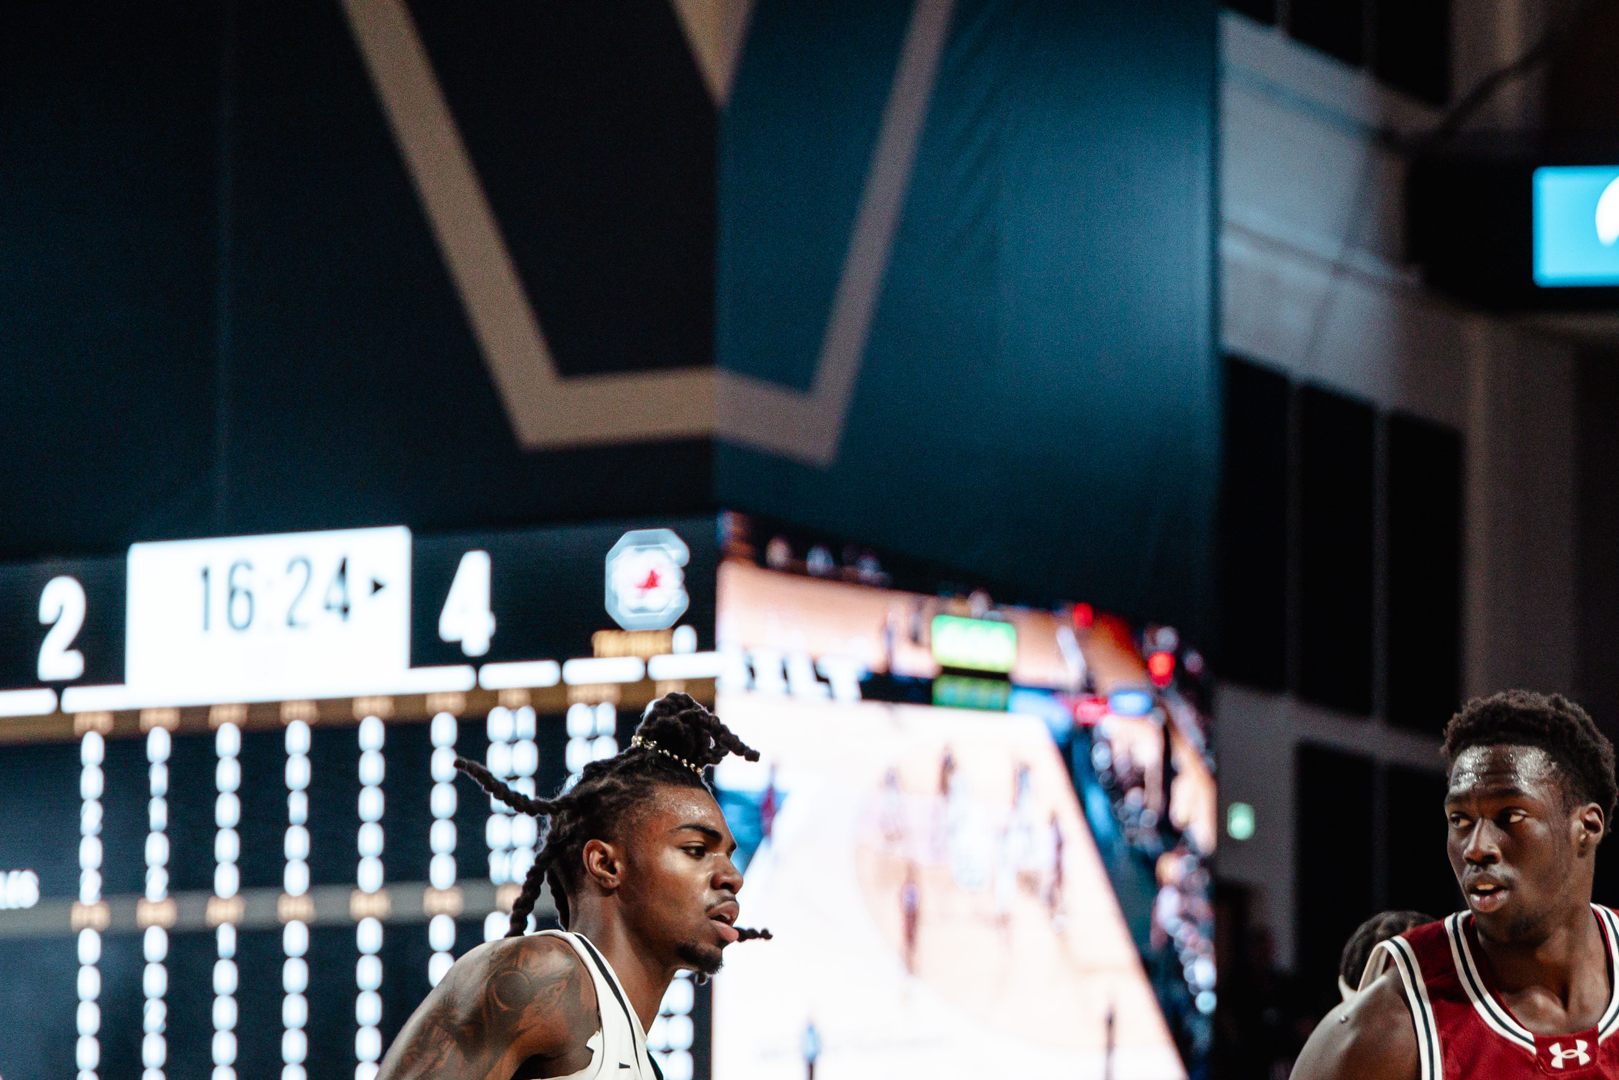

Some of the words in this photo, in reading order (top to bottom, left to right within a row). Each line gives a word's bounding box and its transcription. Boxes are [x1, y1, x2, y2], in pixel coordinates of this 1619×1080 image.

[37, 575, 87, 682] 2
[200, 556, 353, 634] 16:24
[438, 550, 496, 657] 4
